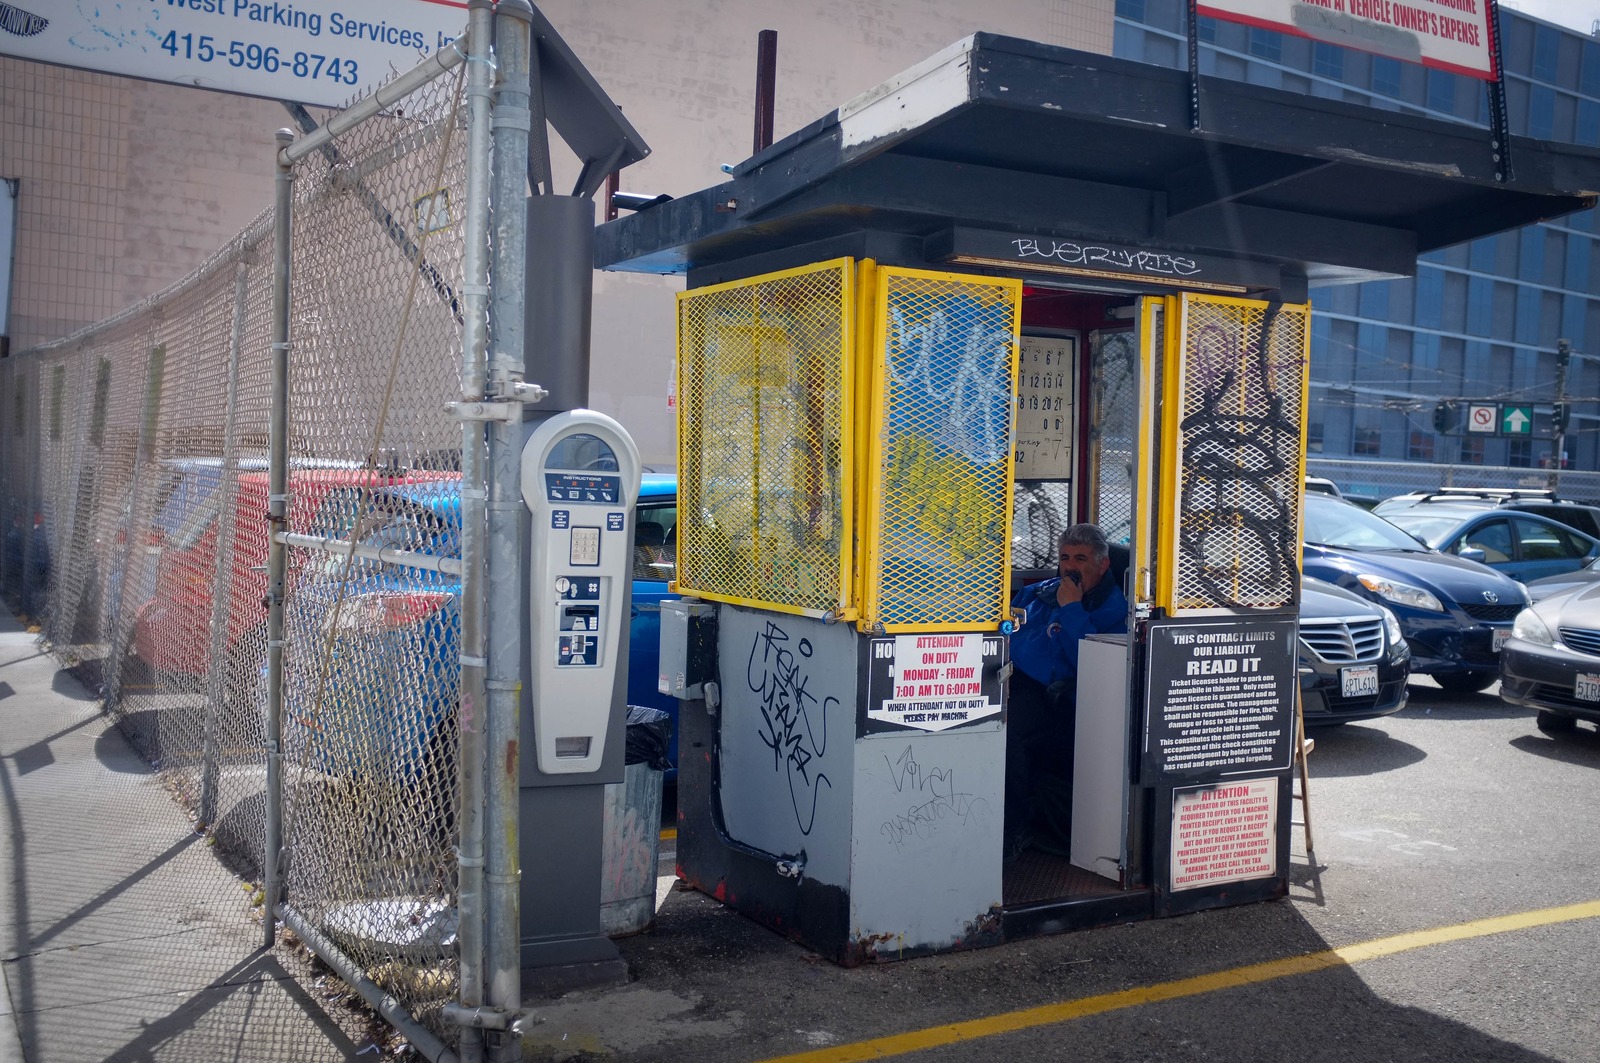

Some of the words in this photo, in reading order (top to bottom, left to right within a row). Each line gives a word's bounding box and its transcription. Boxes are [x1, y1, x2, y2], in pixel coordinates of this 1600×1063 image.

[233, 0, 322, 36] Parking
[329, 12, 430, 54] Services,
[1349, 0, 1391, 24] VEHICLE
[1393, 3, 1438, 36] OWNER'S
[1440, 16, 1480, 47] EXPENSE
[160, 30, 359, 85] 415-596-8743
[1046, 354, 1050, 365] 6
[1030, 376, 1039, 388] 12
[1043, 377, 1051, 388] 13
[1056, 377, 1062, 388] 14
[1029, 398, 1038, 409] 19
[1042, 399, 1051, 410] 20
[1054, 399, 1061, 411] 21
[917, 636, 964, 648] ATTENDANT
[1174, 635, 1194, 644] THIS
[1197, 632, 1244, 644] CONTRACT
[1246, 631, 1275, 641] LIMITS
[876, 643, 895, 658] HO
[982, 641, 997, 656] ON
[1194, 647, 1212, 656] OUR
[1214, 645, 1255, 655] LIABILITY
[922, 653, 935, 664] ON
[936, 652, 958, 663] DUTY
[1187, 659, 1237, 675] READ
[1242, 658, 1261, 672] IT
[904, 669, 940, 681] MONDAY
[946, 667, 975, 679] FRIDAY
[896, 686, 914, 697] 7:00
[918, 685, 932, 696] AM
[934, 685, 944, 695] TO
[947, 683, 965, 695] 6:00
[968, 683, 980, 694] PM
[1168, 687, 1204, 695] automobile
[888, 703, 907, 711] WHEN
[908, 702, 944, 711] ATTENDANT
[945, 701, 957, 709] NOT
[958, 700, 967, 708] ON
[969, 700, 984, 708] DUTY
[1239, 698, 1279, 707] management
[903, 713, 926, 723] PLEASE
[928, 713, 940, 721] PAY
[942, 712, 968, 720] MACHINE
[1202, 709, 1238, 718] responsible
[1175, 736, 1210, 744] constitutes
[1242, 730, 1267, 738] contract
[1205, 758, 1227, 766] agrees
[1202, 786, 1249, 801] ATTENTION
[1193, 802, 1219, 811] OPERATOR
[1181, 812, 1206, 821] REQUIRED
[1246, 805, 1269, 813] MACHINE
[1180, 821, 1201, 830] PRINTED
[1220, 825, 1242, 833] REQUEST
[1215, 835, 1235, 843] RECEIVE
[1241, 831, 1264, 840] MACHINE
[1177, 848, 1199, 857] PRINTED
[1247, 839, 1269, 847] CONTEST
[1189, 855, 1211, 864] AMOUNT
[1233, 849, 1257, 859] CHARGED
[1176, 873, 1208, 883] COLLECTOR'S
[1209, 869, 1226, 878] OFFICE
